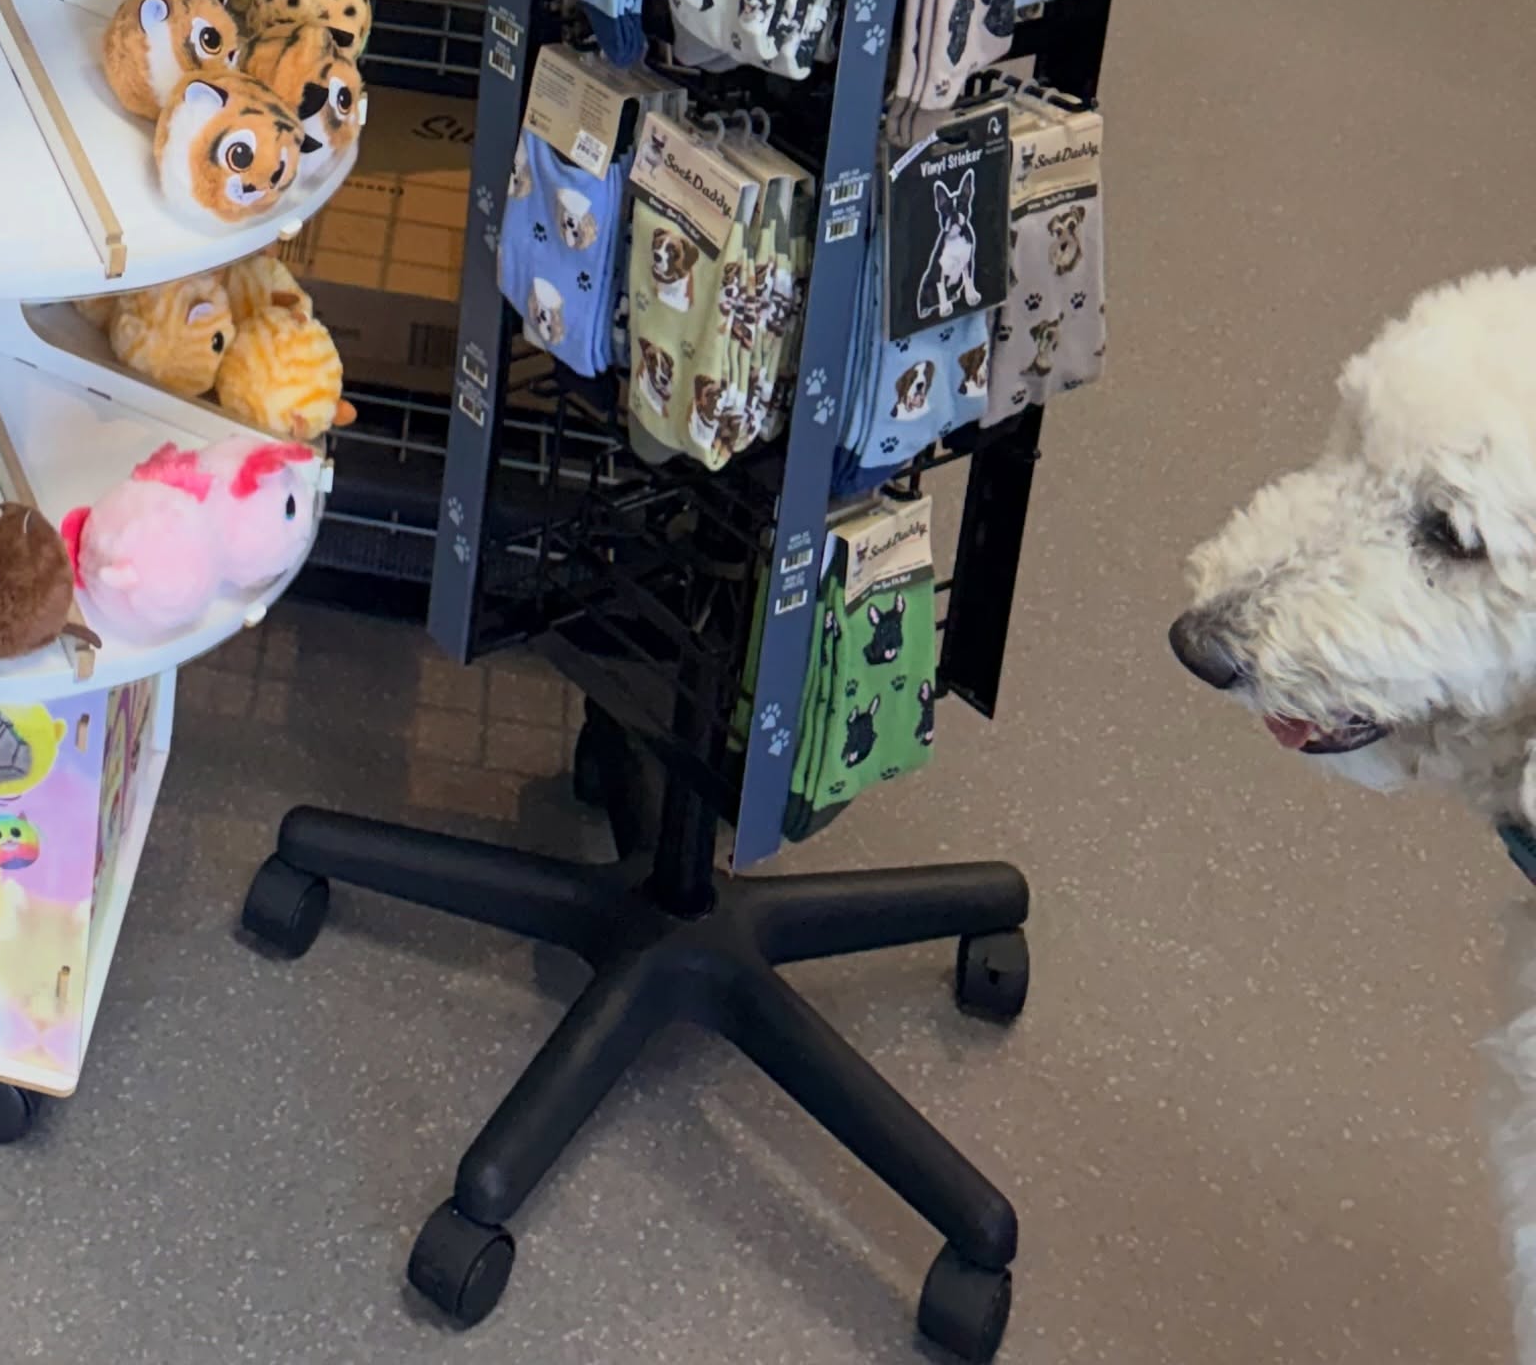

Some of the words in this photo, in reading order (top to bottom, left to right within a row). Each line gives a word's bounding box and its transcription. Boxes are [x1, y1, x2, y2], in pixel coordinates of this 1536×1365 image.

[947, 147, 984, 170] Sticker
[1035, 141, 1100, 170] SockDaddy
[664, 152, 734, 224] SockDaddy
